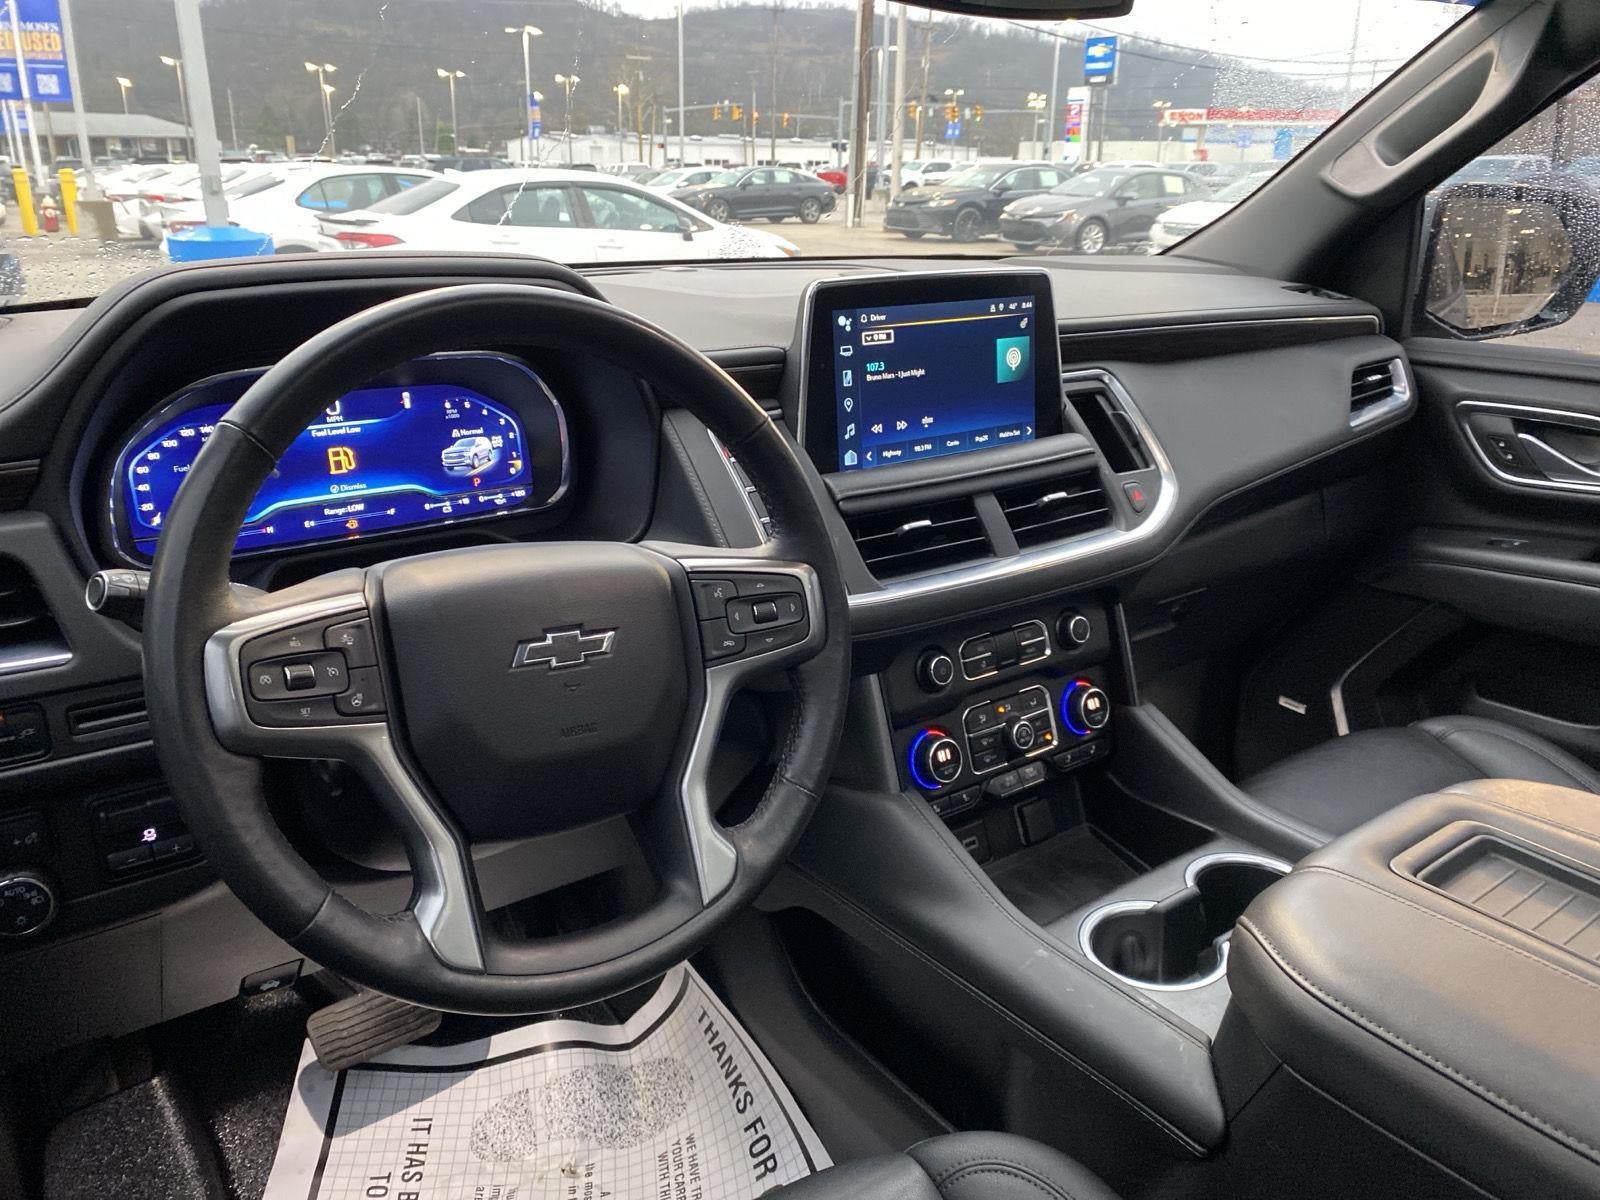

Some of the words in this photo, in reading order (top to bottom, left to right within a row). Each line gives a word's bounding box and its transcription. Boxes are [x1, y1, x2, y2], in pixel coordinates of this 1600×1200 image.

[22, 31, 62, 52] USED
[870, 313, 887, 322] Driver
[866, 361, 885, 372] 107.3
[866, 373, 882, 382] Bruno
[882, 371, 895, 380] Mars
[326, 415, 343, 423] MPH
[180, 428, 195, 437] 120
[311, 429, 327, 437] Fuel
[328, 427, 346, 435] Level
[346, 425, 361, 433] Low
[460, 427, 484, 436] Normal
[162, 439, 178, 448] 100
[340, 482, 367, 492] Dismiss
[473, 477, 480, 487] P
[697, 1005, 754, 1115] THANKS
[743, 1116, 778, 1183] FOR
[411, 1117, 433, 1135] IT
[685, 1132, 696, 1153] WE
[671, 1139, 684, 1171] YOUR
[401, 1142, 429, 1184] HAS
[584, 1161, 595, 1178] the
[658, 1150, 670, 1181] WITH
[688, 1153, 701, 1184] HAVE
[366, 1171, 391, 1199] TO
